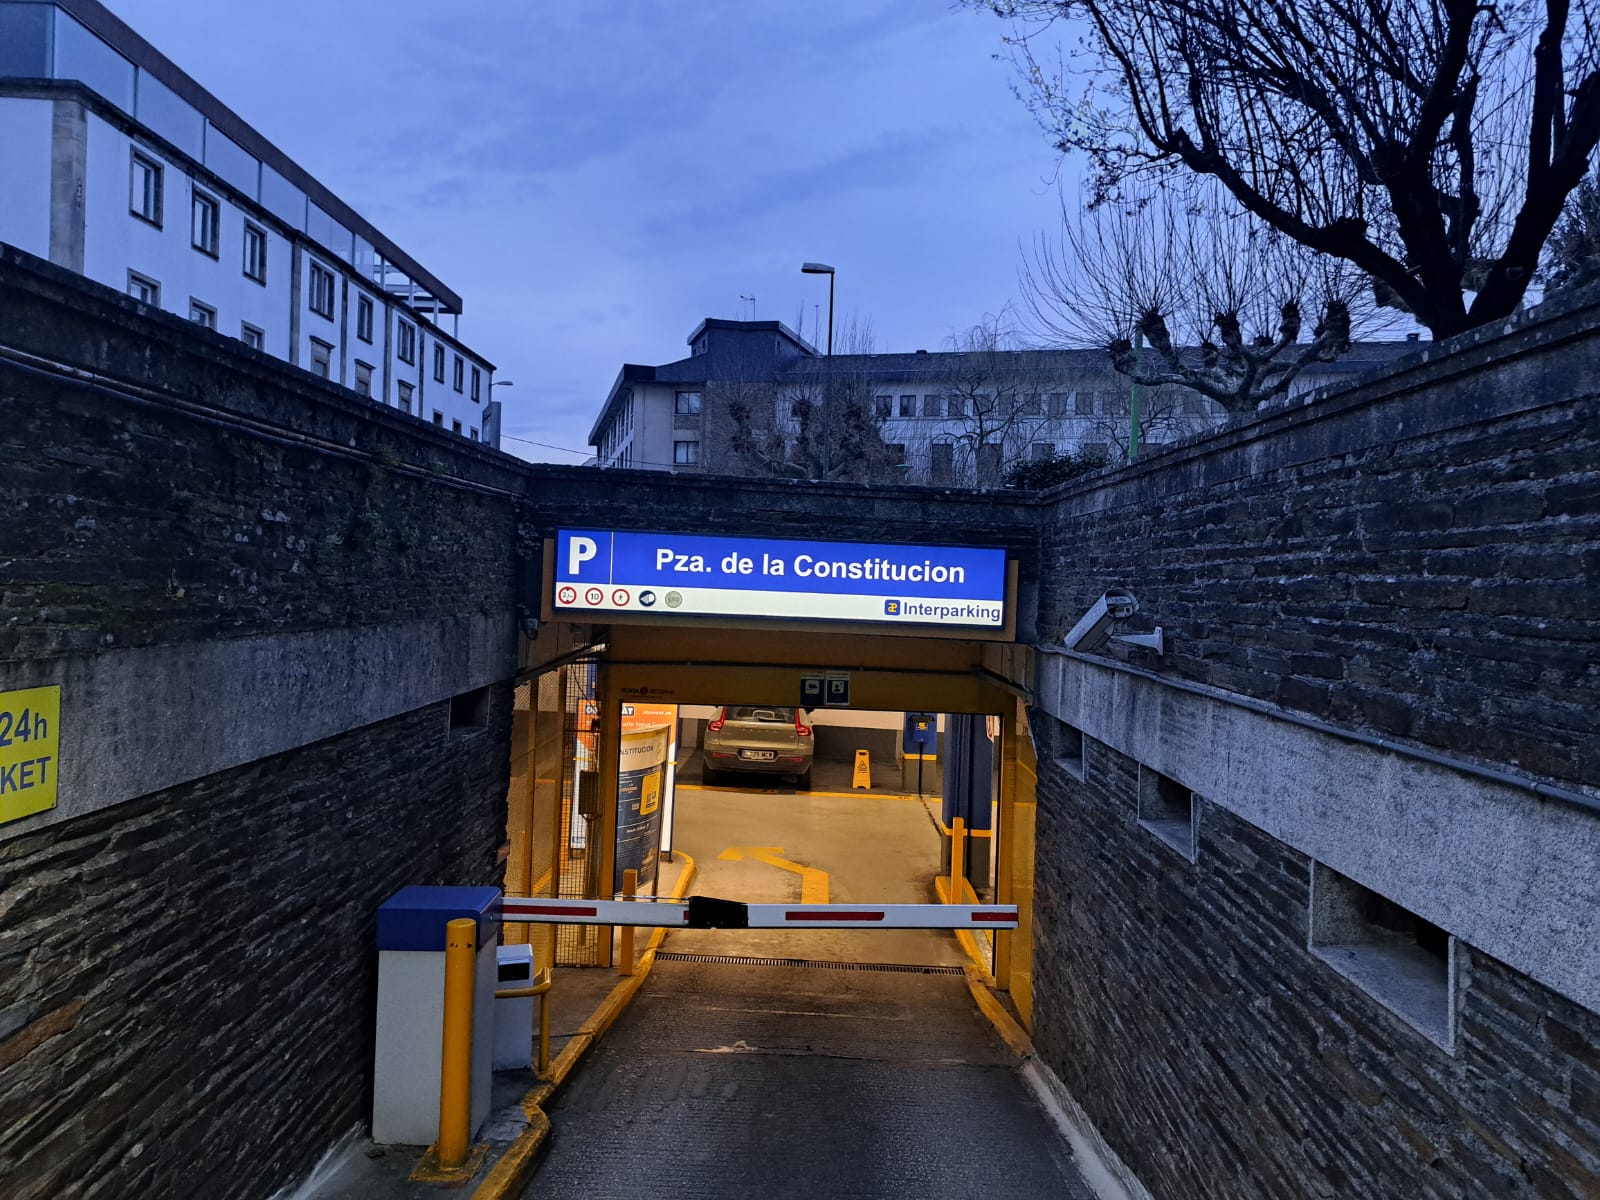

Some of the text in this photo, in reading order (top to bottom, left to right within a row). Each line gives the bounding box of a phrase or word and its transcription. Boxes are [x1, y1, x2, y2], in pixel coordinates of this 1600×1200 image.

[568, 536, 597, 575] P
[656, 549, 965, 583] Pza. de la Constitucion
[590, 592, 600, 601] 10
[903, 602, 1000, 622] Interparking
[0, 708, 48, 748] 24h
